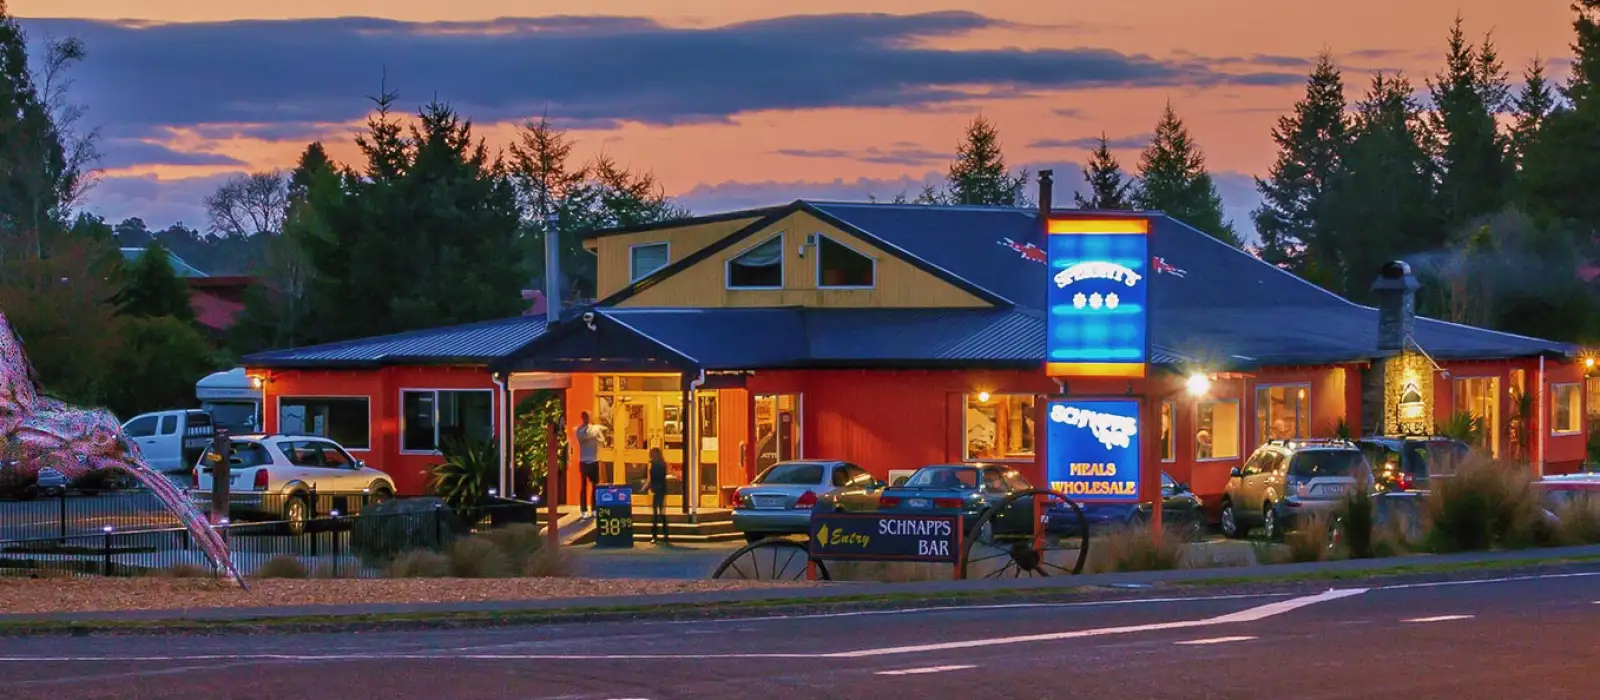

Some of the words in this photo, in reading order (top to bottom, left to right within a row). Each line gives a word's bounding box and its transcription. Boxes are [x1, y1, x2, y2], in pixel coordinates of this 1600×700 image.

[1069, 463, 1117, 477] MEALS
[1050, 481, 1137, 496] WHOLESALE
[598, 507, 611, 518] 24
[600, 518, 620, 536] 38
[878, 519, 951, 536] SCHNAPPS
[830, 528, 870, 548] Entry
[918, 540, 949, 556] BAR
